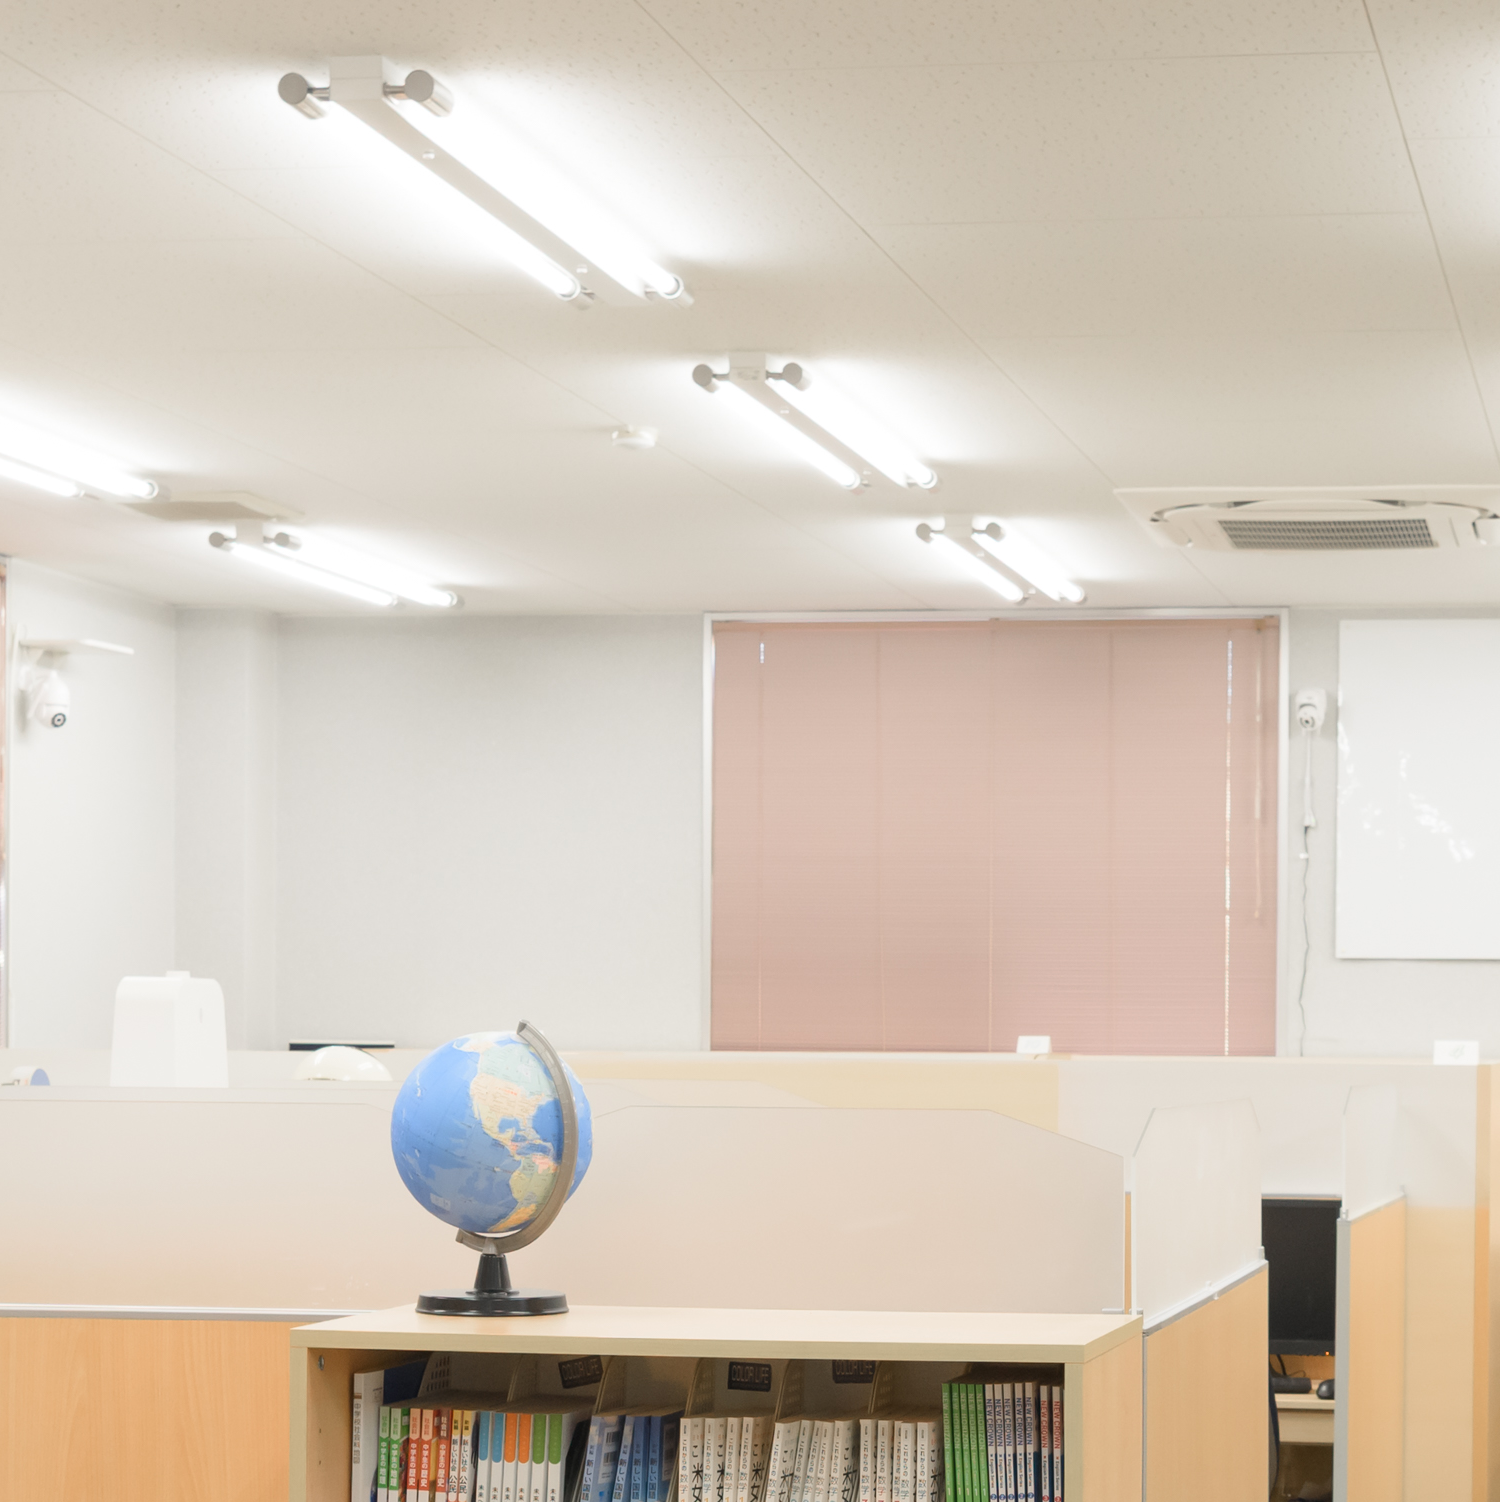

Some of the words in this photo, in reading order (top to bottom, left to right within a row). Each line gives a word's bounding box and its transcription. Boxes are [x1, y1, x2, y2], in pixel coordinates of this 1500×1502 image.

[986, 1398, 994, 1416] NEW
[986, 1418, 994, 1446] CROWN
[379, 1442, 387, 1485] 中学生の地理
[437, 1444, 446, 1488] 中学生の歴史
[459, 1475, 467, 1494] 公民
